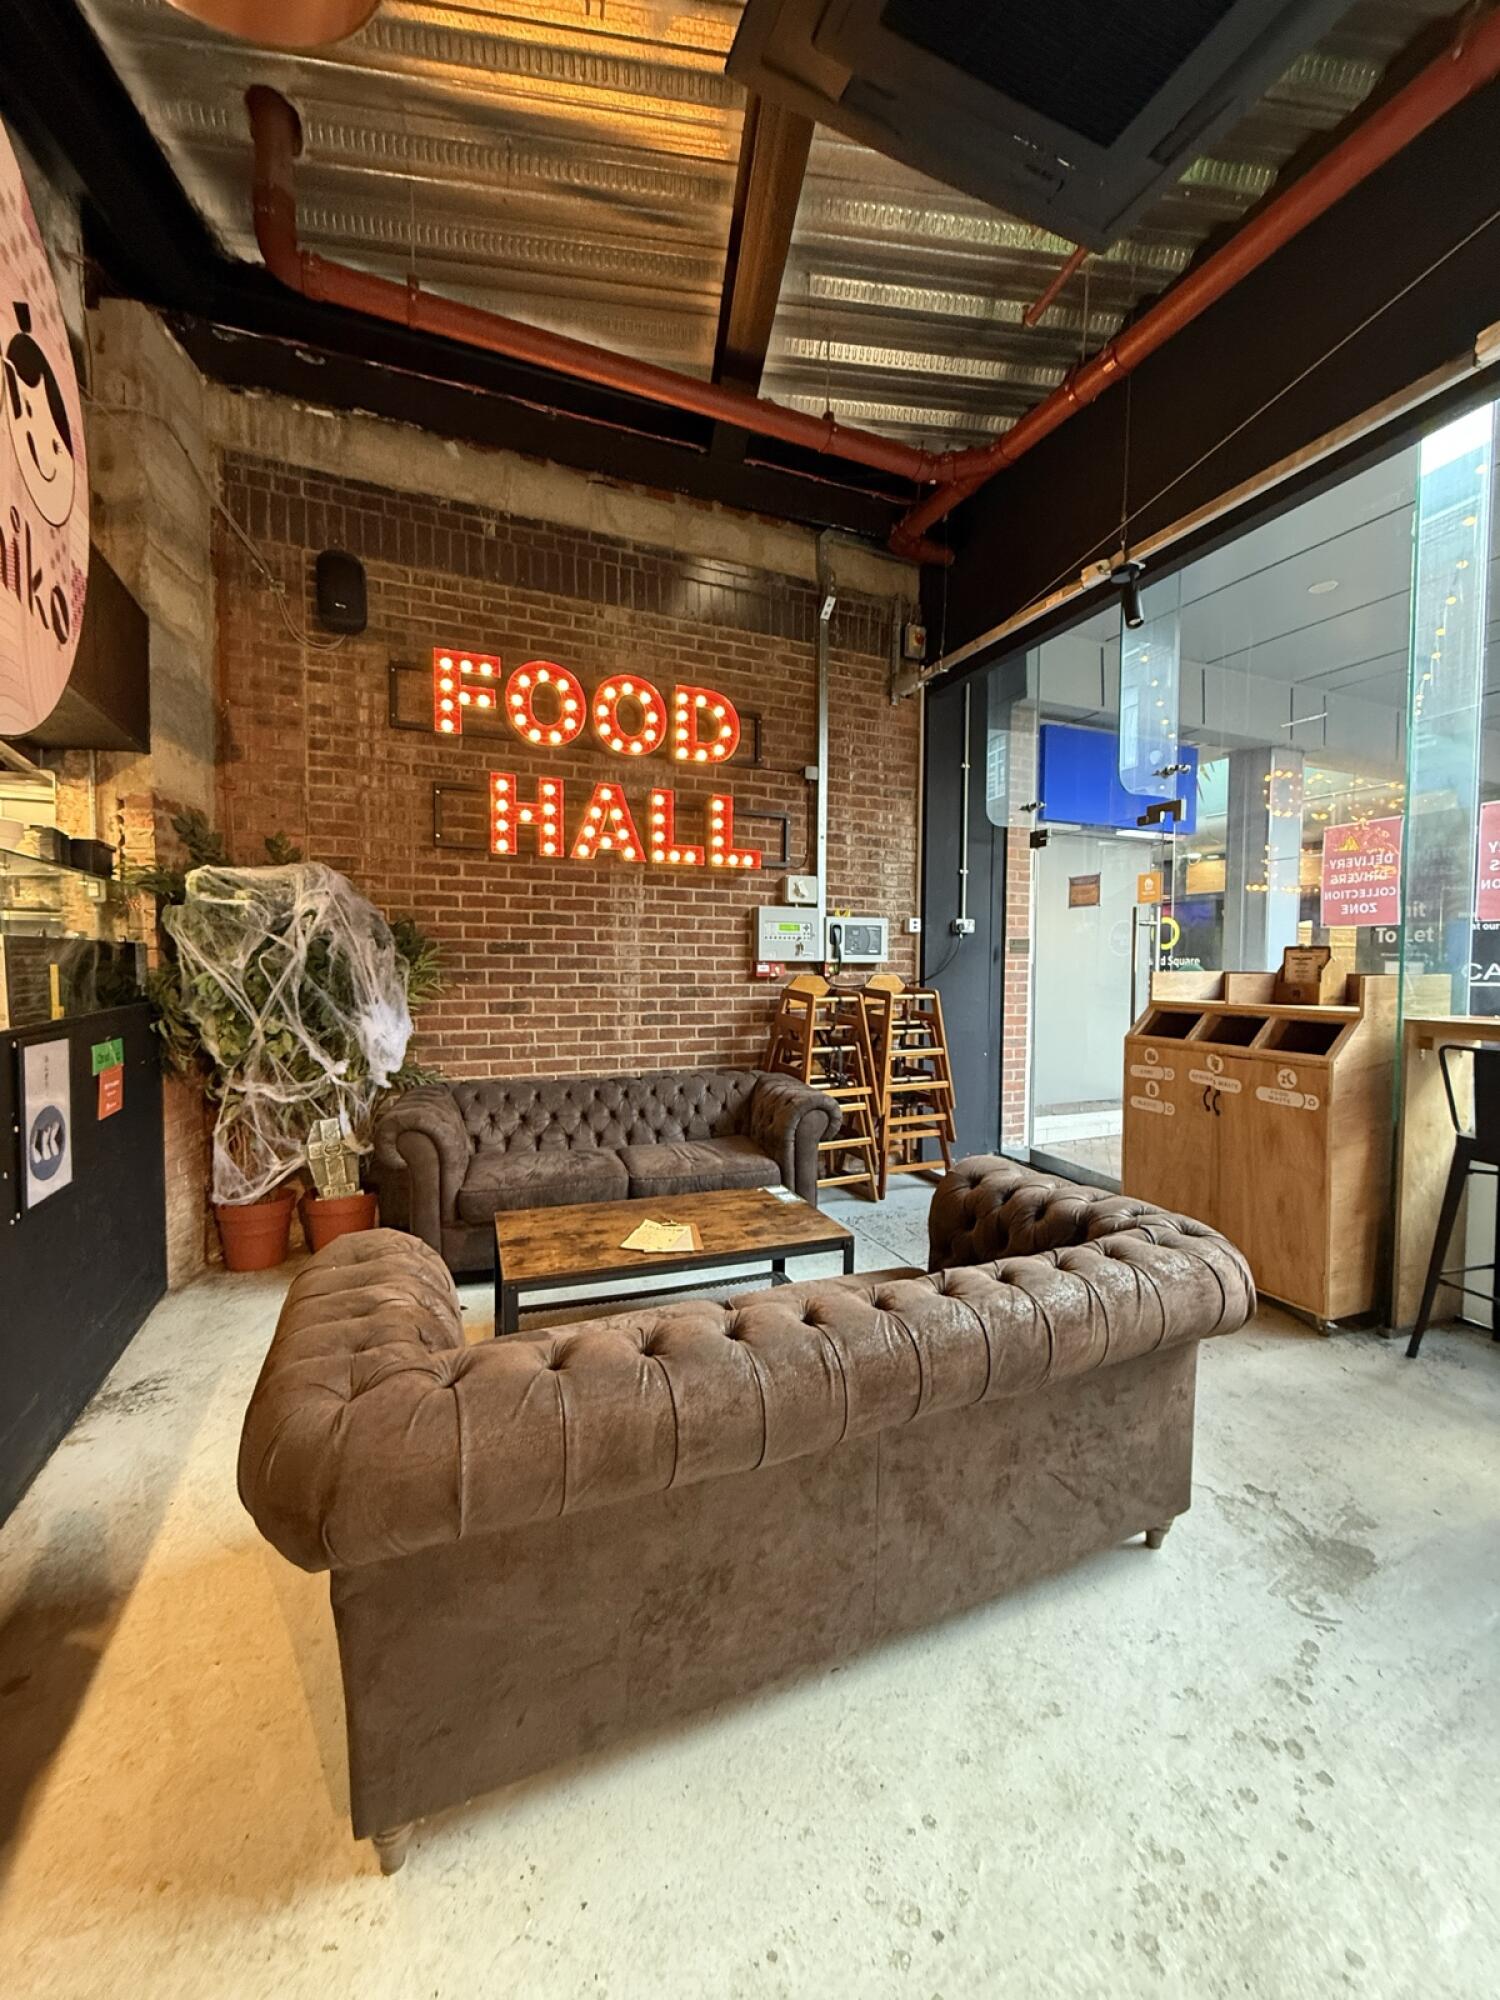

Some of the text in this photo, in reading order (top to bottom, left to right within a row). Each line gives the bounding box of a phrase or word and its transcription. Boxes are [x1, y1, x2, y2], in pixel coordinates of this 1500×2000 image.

[433, 647, 741, 763] FOOD
[490, 772, 761, 870] HALL
[1167, 955, 1201, 968] Square
[1375, 927, 1397, 943] To
